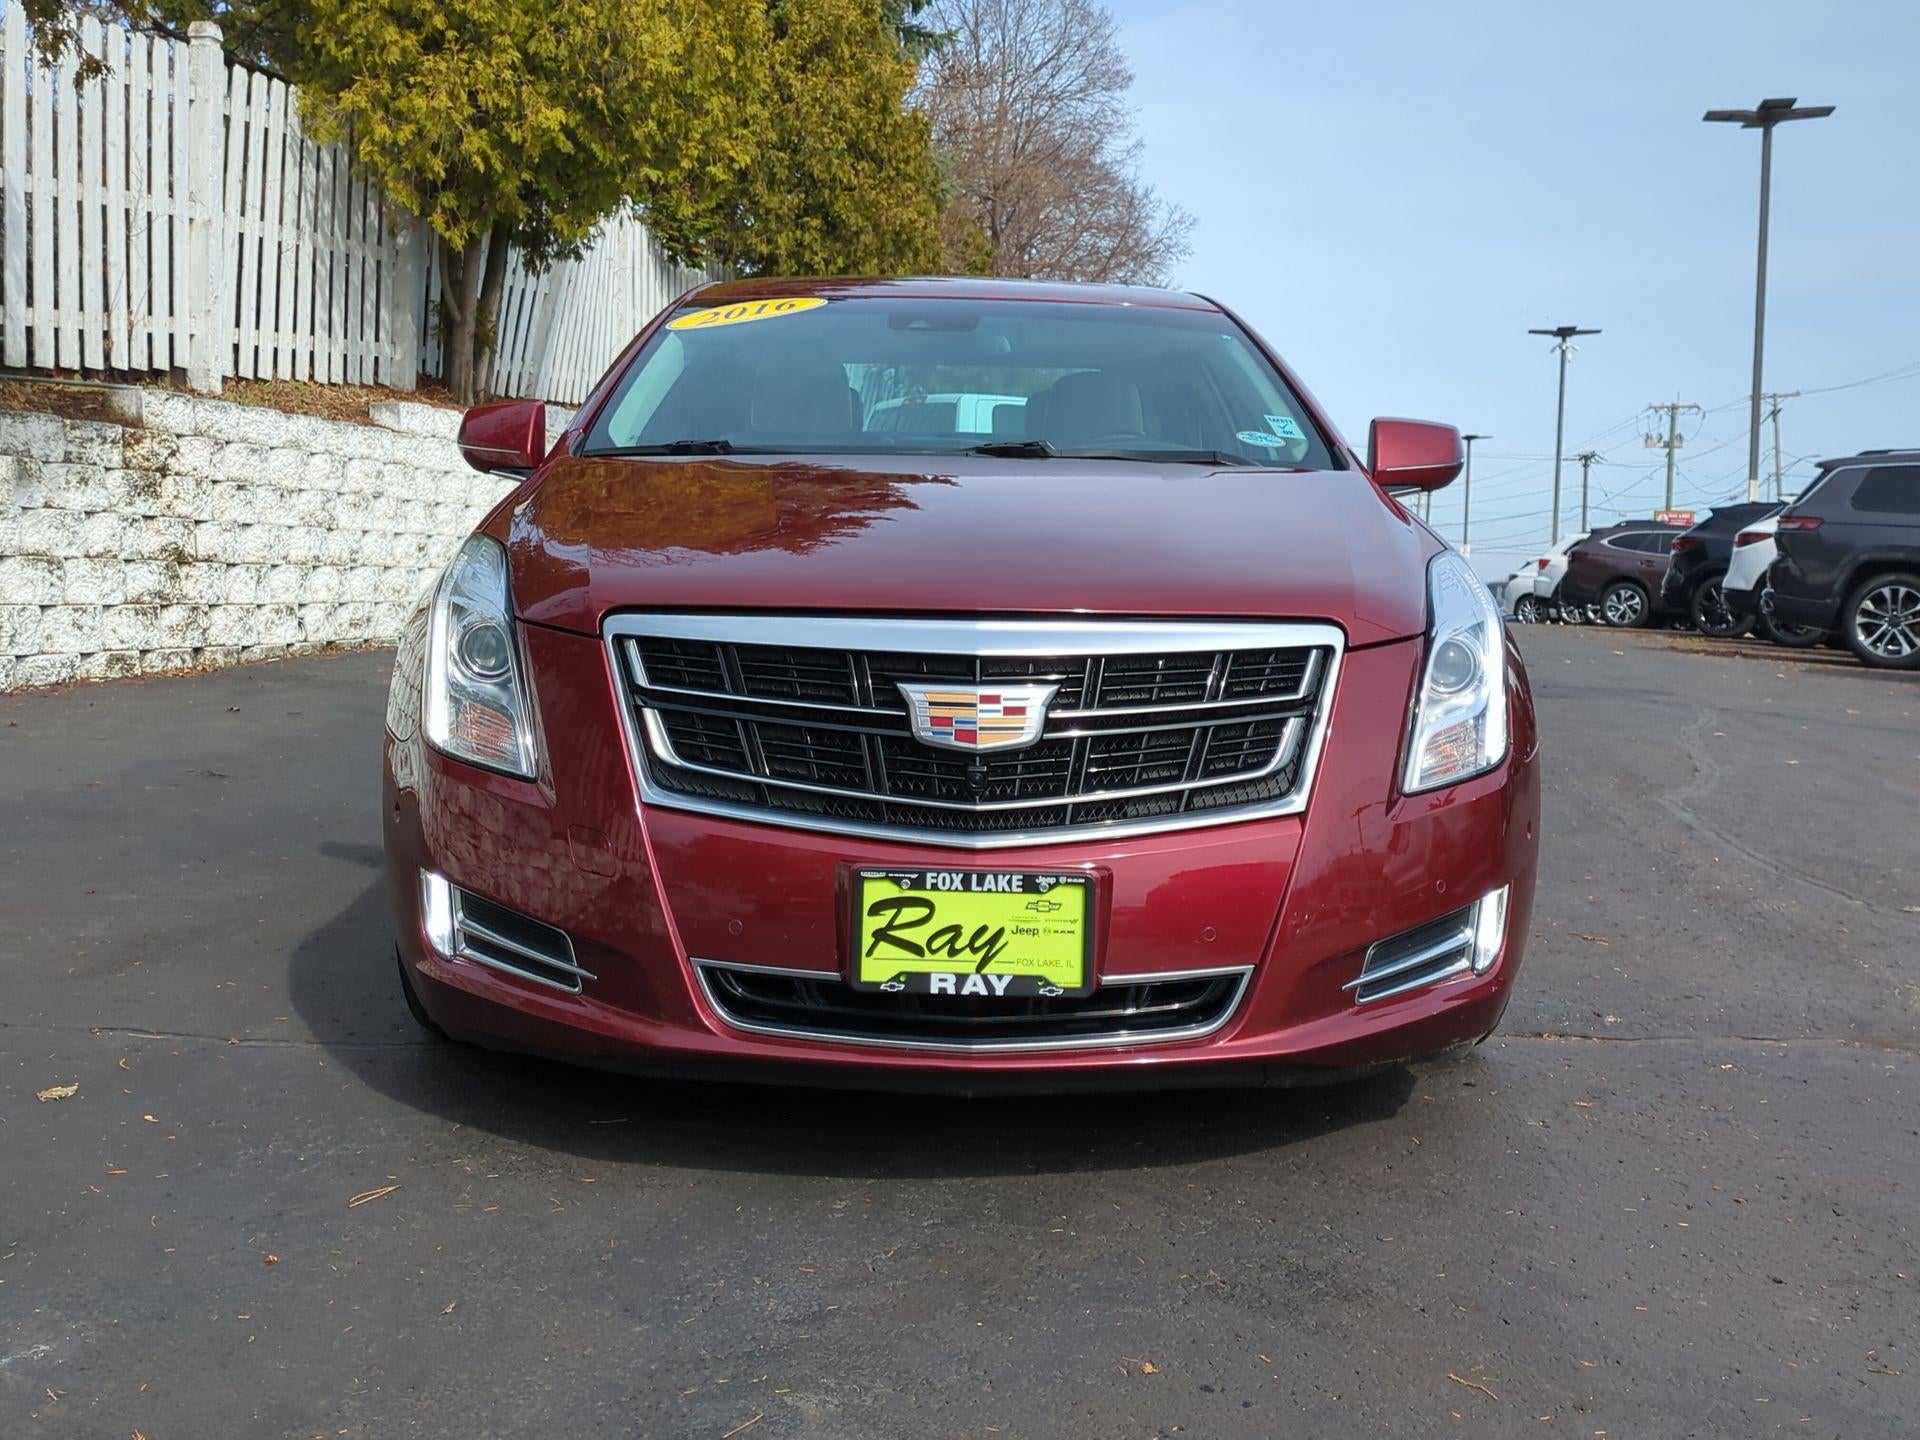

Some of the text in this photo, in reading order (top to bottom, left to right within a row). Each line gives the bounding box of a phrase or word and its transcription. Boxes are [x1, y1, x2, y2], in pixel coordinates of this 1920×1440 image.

[695, 301, 797, 326] 2016
[925, 871, 1023, 893] FOX LAKE
[865, 896, 1009, 974] Ray
[1011, 925, 1040, 938] Jeep
[1016, 958, 1074, 969] FOX LAKE, IL
[929, 972, 1014, 997] RAY
